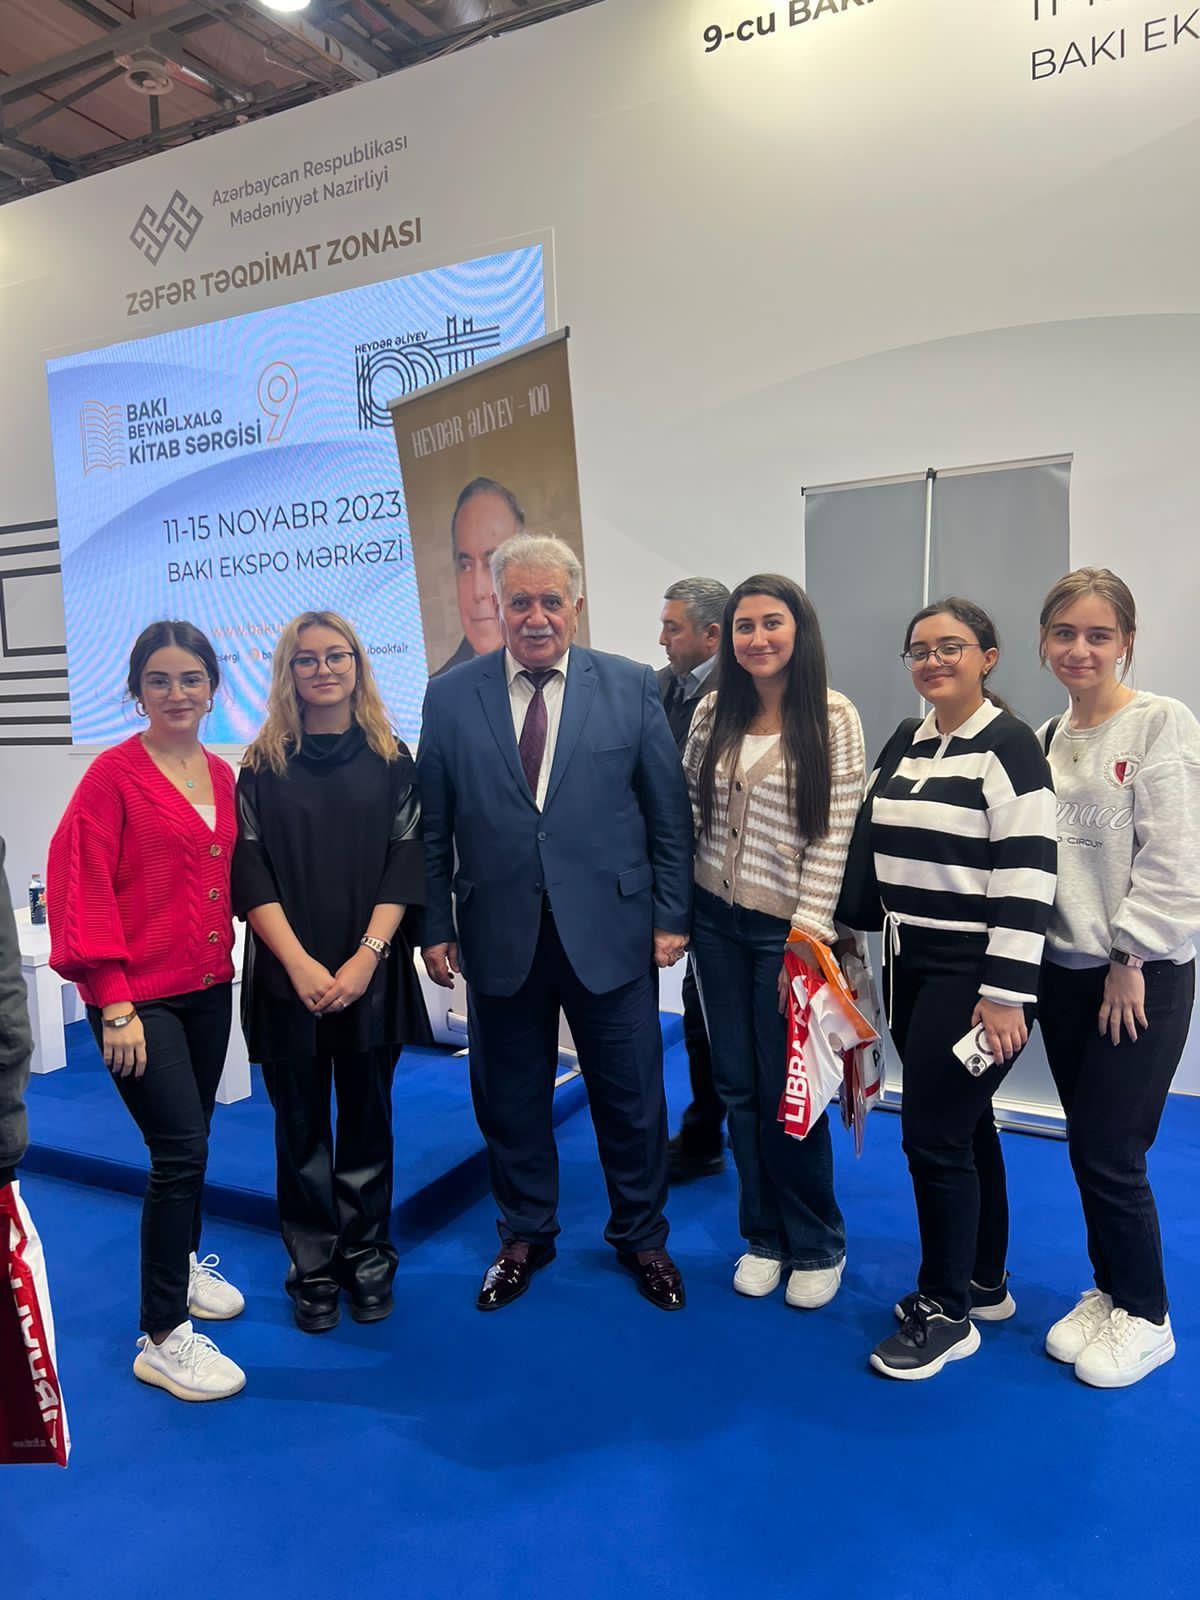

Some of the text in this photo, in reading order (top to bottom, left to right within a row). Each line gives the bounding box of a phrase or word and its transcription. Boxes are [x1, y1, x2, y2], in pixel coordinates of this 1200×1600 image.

[703, 0, 874, 53] 9-cu BA
[1032, 28, 1125, 80] BAKI
[212, 135, 409, 207] Azərbaycan Respublikası
[230, 166, 390, 228] Mədəniyyət Nazirliyi
[126, 217, 423, 316] ZƏFƏR TƏQDİMAT ZONASI
[354, 331, 428, 354] HEYDƏR ƏLİYEV
[127, 397, 167, 422] BAKI
[128, 409, 222, 440] BEYNƏLXALQ
[411, 415, 464, 459] HEYDƏR
[467, 396, 513, 438] ƏLİYEV
[528, 383, 550, 417] 100
[129, 419, 262, 464] KİTAB SƏRGİSİ
[163, 491, 401, 544] 11-15 NOYABR 2023
[168, 534, 403, 582] BAKI EKSPO MƏRKƏZİ
